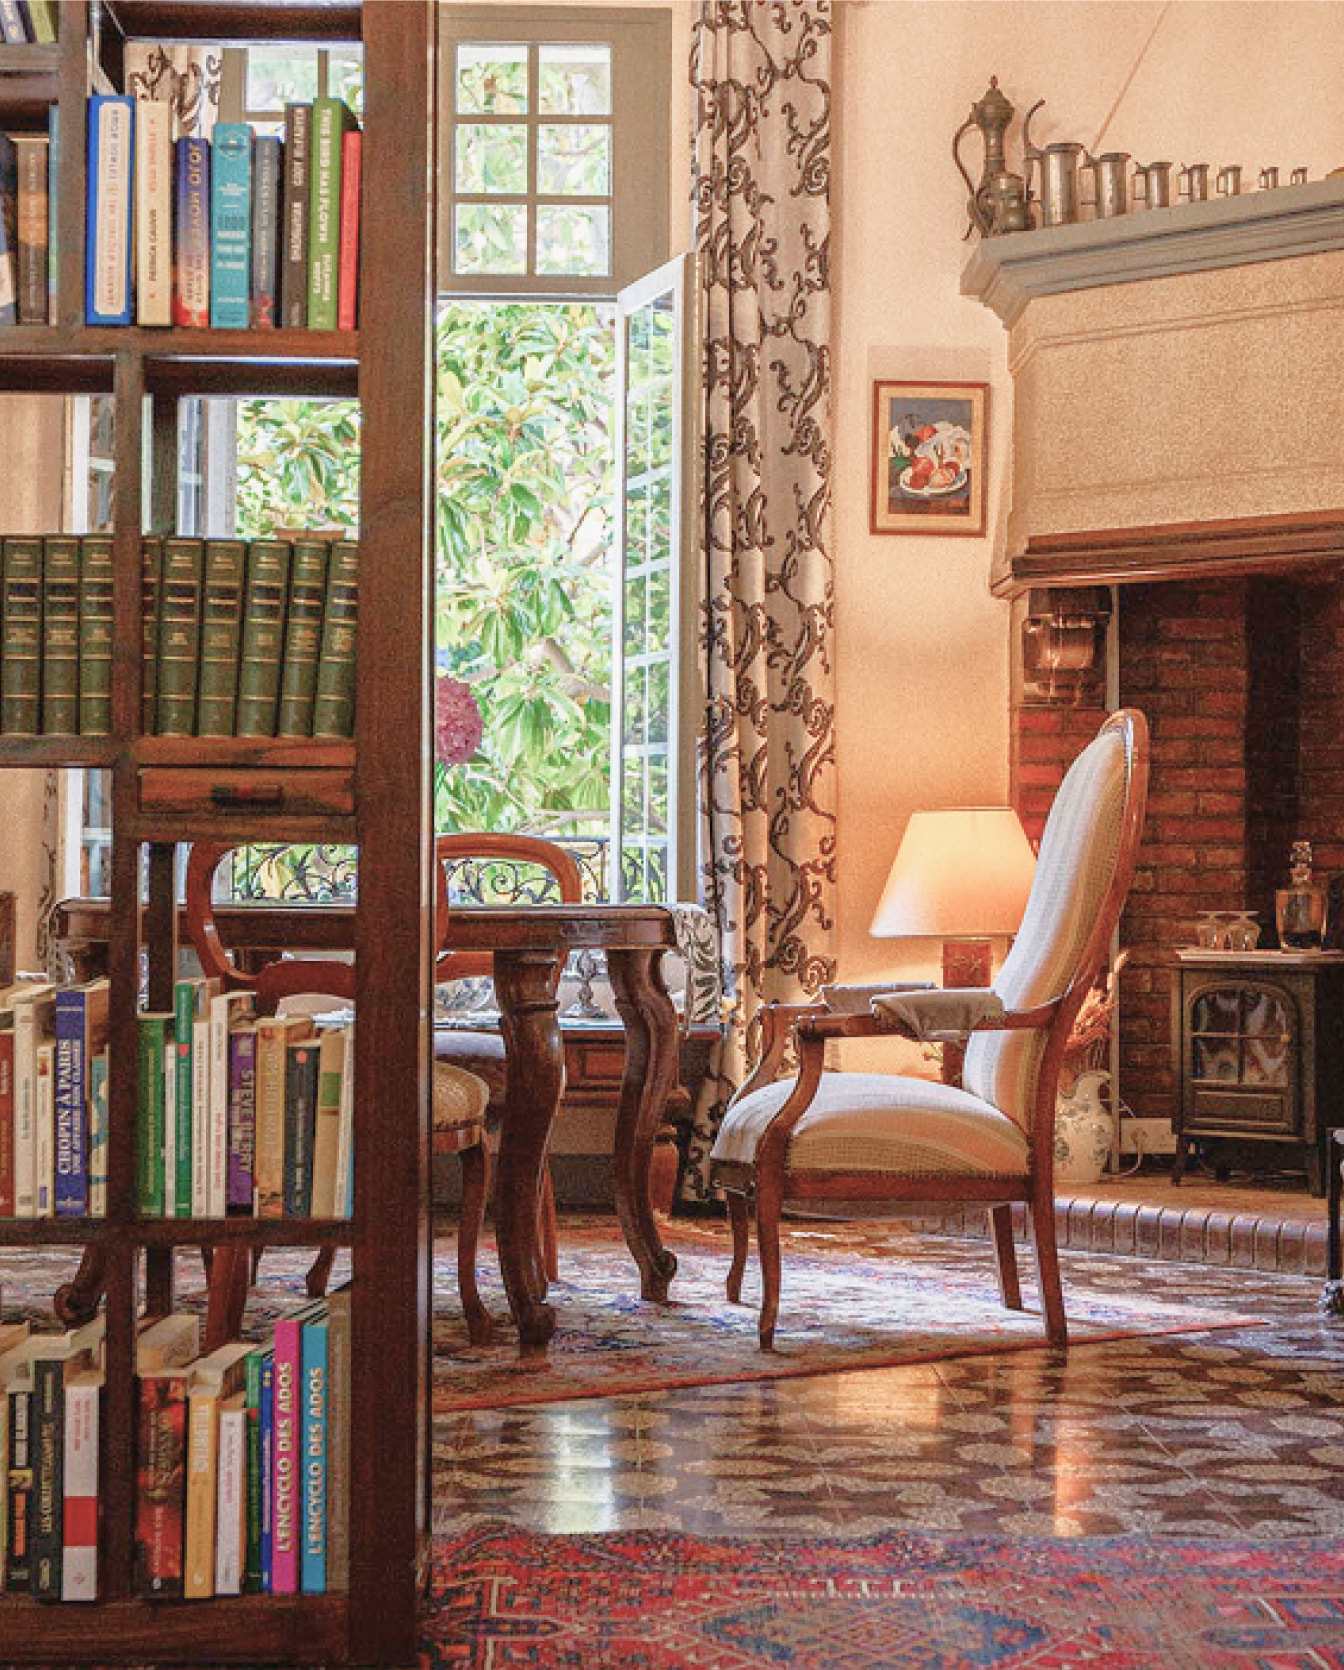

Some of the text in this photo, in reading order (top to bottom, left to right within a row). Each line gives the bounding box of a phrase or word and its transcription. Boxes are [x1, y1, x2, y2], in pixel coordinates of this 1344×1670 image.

[186, 144, 203, 247] JOJO MOYES
[317, 107, 333, 244] THIS BIRD HAS FLOWN
[57, 1038, 71, 1090] PARIS
[241, 1068, 254, 1121] STEVE
[57, 1108, 71, 1175] CHOPIN
[276, 1362, 292, 1552] L'ENCYCLO DES ADOS
[307, 1367, 323, 1554] L'ENCYCLO DES ADOS
